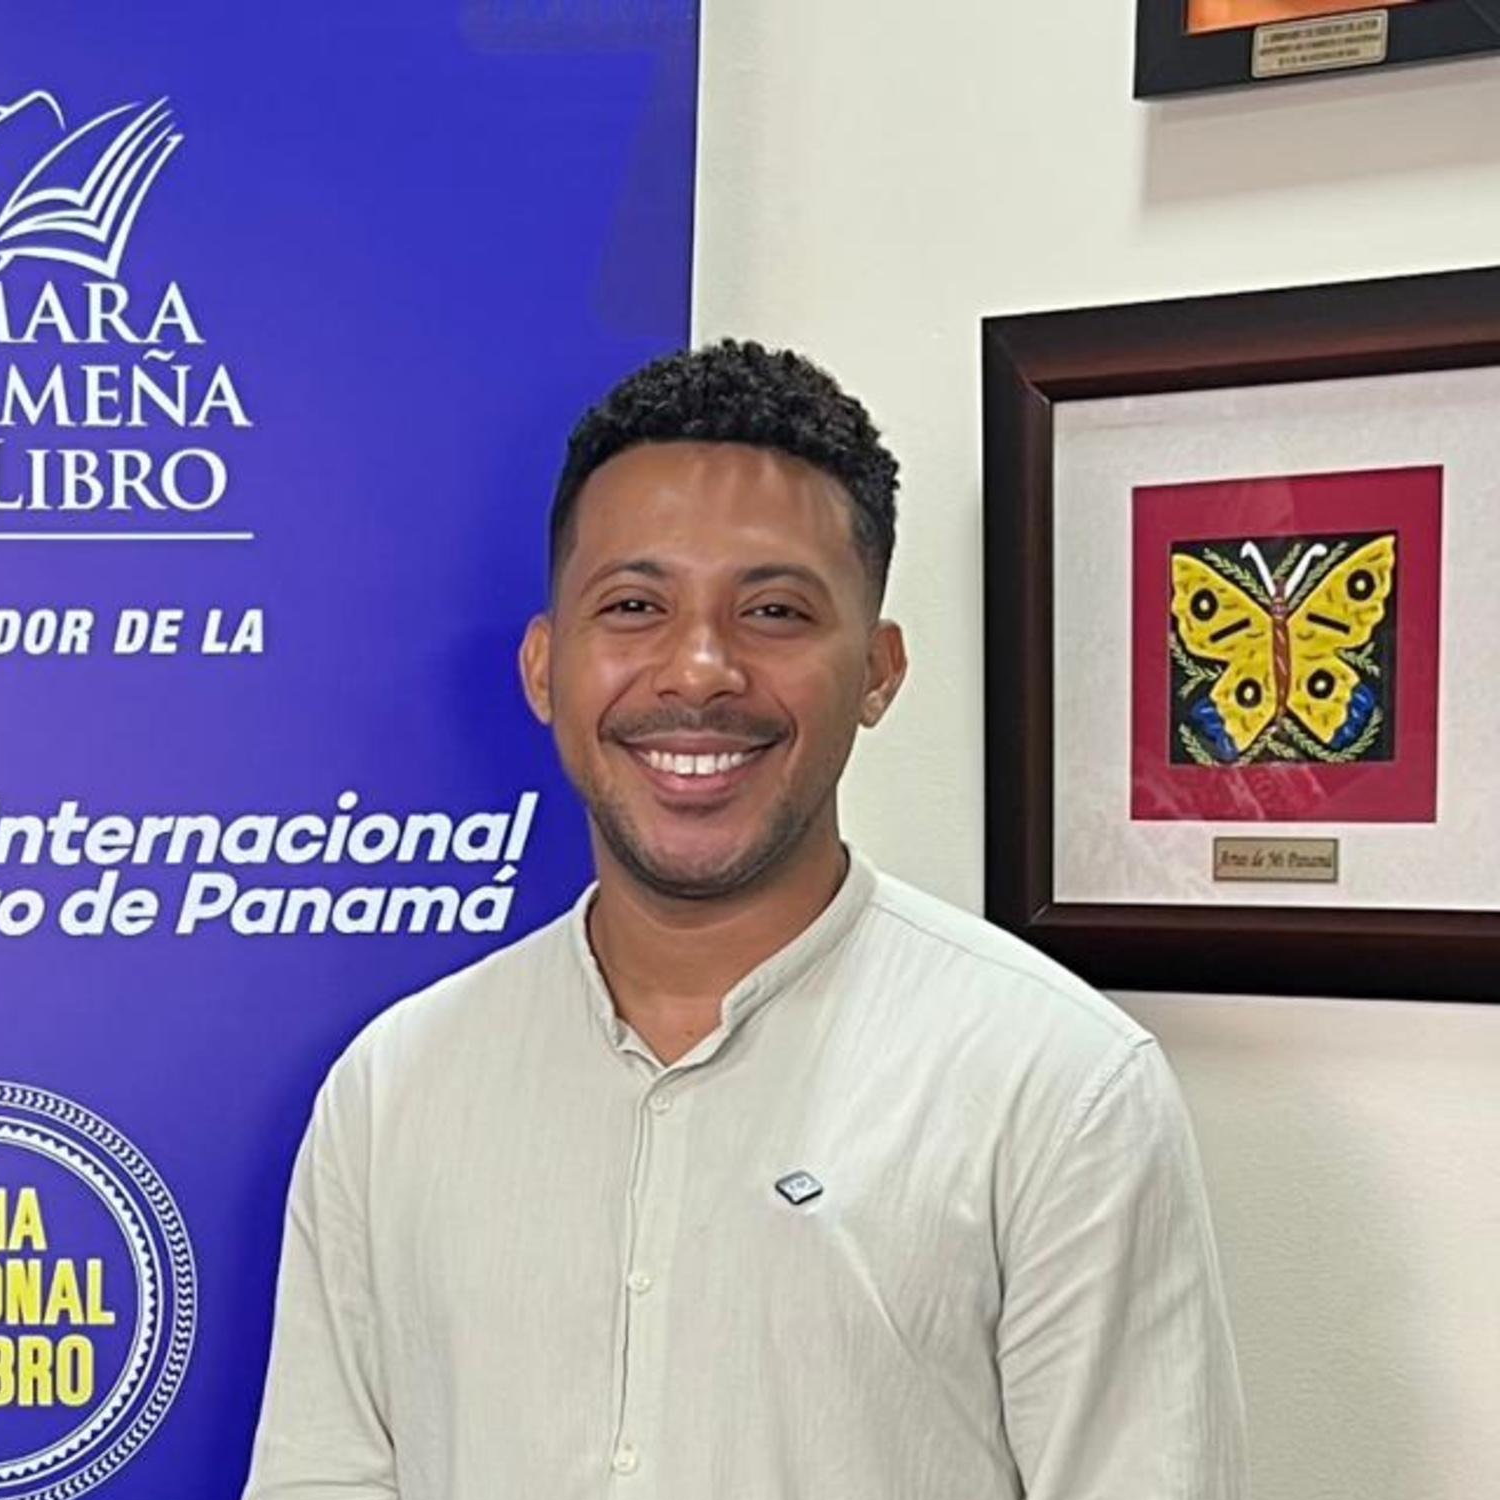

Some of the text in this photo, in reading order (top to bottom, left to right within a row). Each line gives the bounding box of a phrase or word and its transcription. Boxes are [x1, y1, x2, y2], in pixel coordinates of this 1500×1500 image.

[114, 609, 184, 654] DE
[201, 609, 264, 654] LA
[58, 870, 160, 936] de
[176, 867, 516, 936] Panamá
